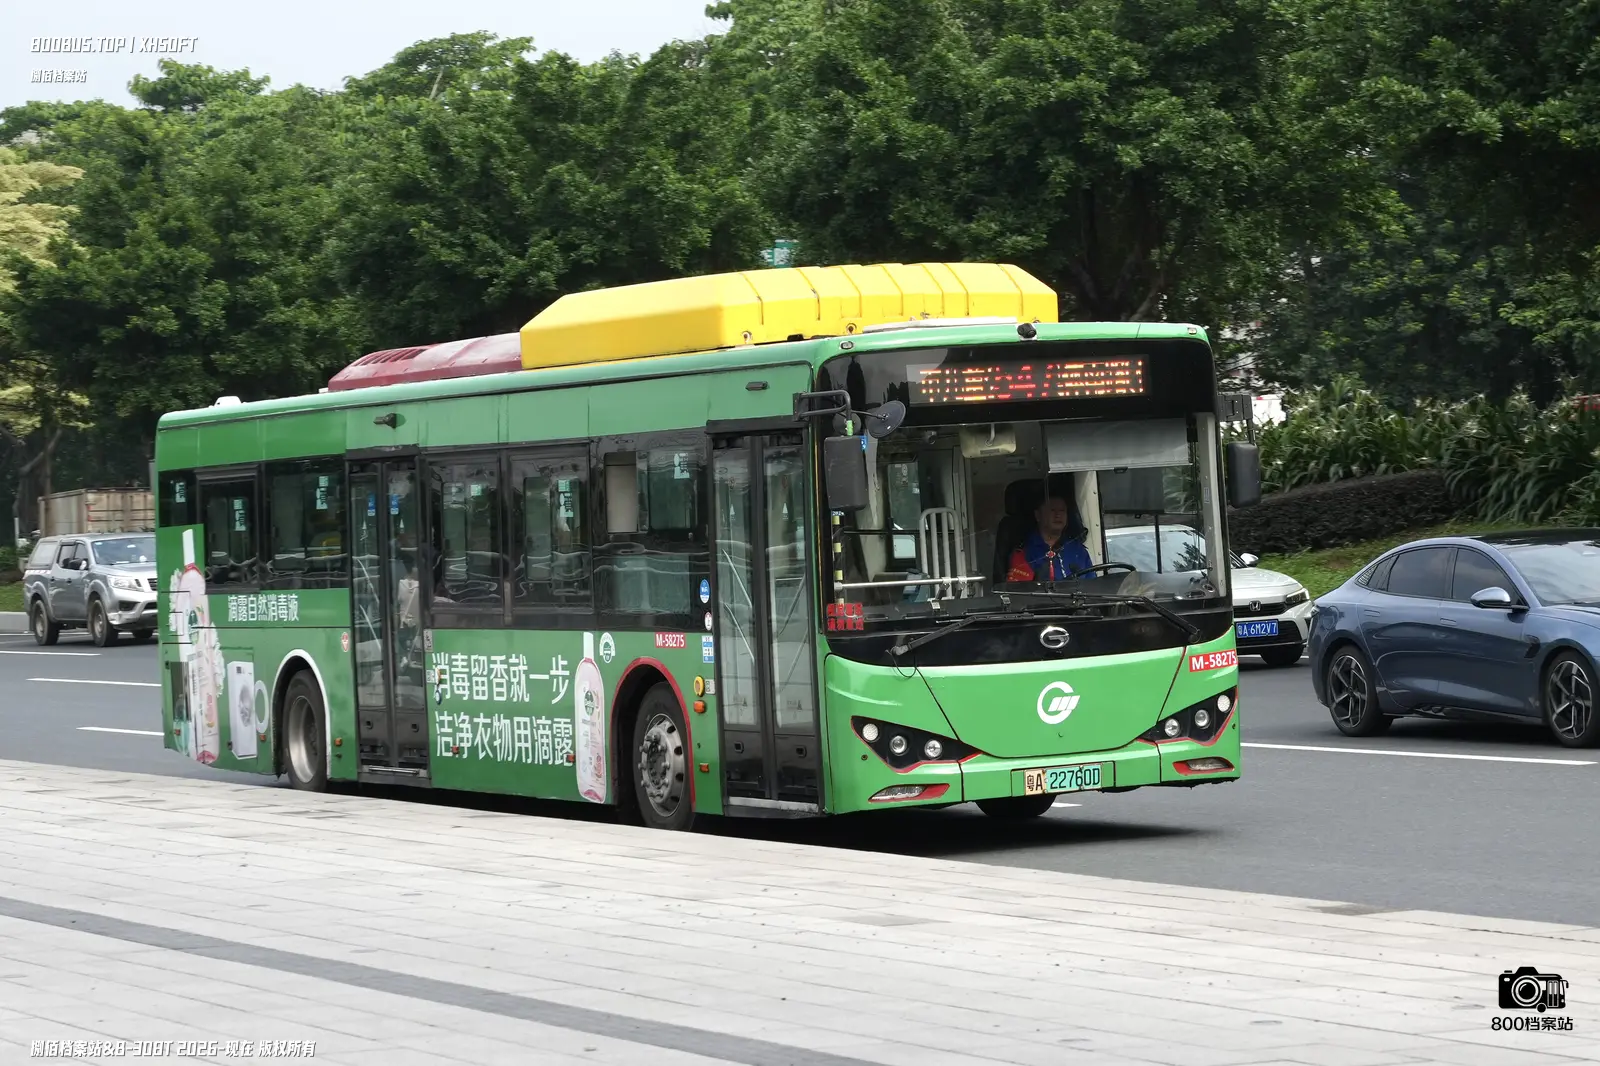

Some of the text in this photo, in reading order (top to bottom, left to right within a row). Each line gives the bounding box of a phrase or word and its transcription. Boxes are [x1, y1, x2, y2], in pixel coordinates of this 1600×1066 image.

[227, 593, 299, 622] 滴露自然消毒液
[656, 633, 685, 648] M-58275
[1191, 651, 1237, 671] M-58275
[431, 651, 570, 705] 消毒留香就一步
[435, 710, 575, 767] 洁净衣物用滴露
